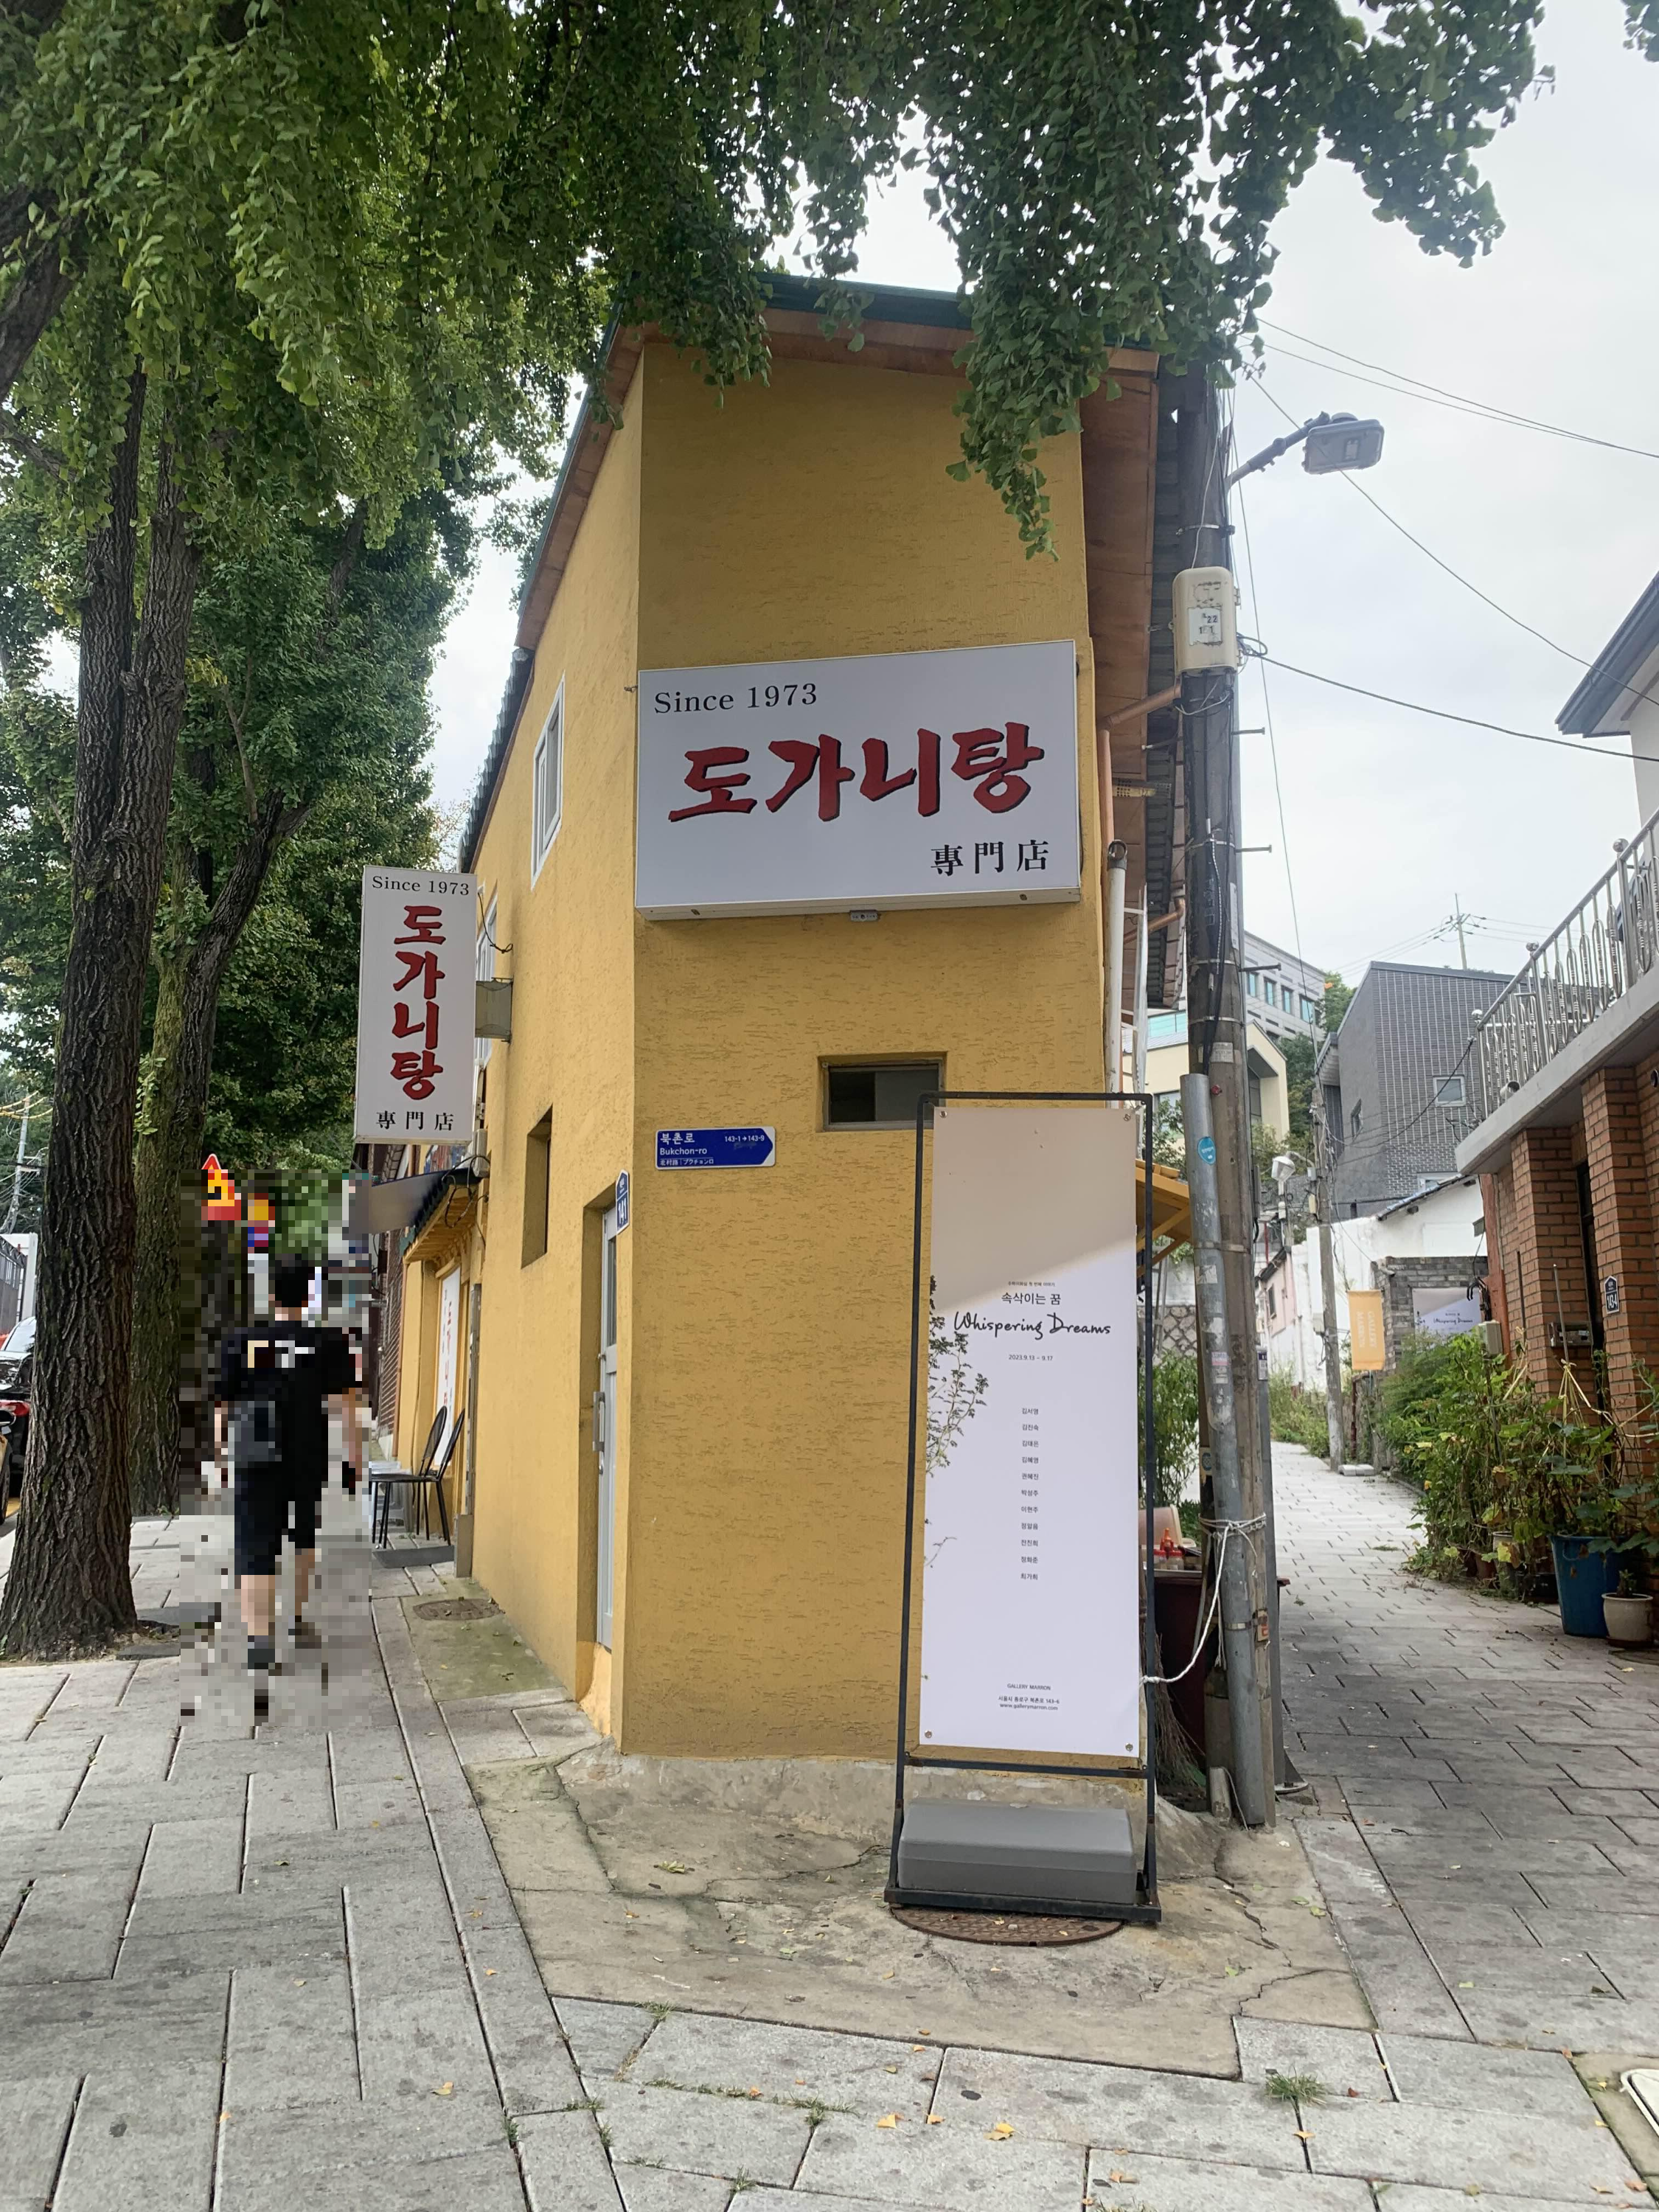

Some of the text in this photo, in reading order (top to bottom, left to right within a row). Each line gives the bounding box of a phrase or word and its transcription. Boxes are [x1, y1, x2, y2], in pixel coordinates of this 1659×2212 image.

[1208, 615, 1217, 623] 22
[654, 683, 817, 714] Since 1973
[668, 722, 1045, 822] 도가니탕
[931, 840, 1048, 876] 專門店
[372, 875, 470, 896] Since 1973
[390, 905, 446, 1100] 도가니탕
[376, 1110, 453, 1130] 專門店
[660, 1133, 695, 1145] 북촌로
[659, 1147, 708, 1156] Bukchon-ro
[1001, 1293, 1062, 1305] 속삭이는 꿈
[954, 1311, 1111, 1340] Whispering Dreams
